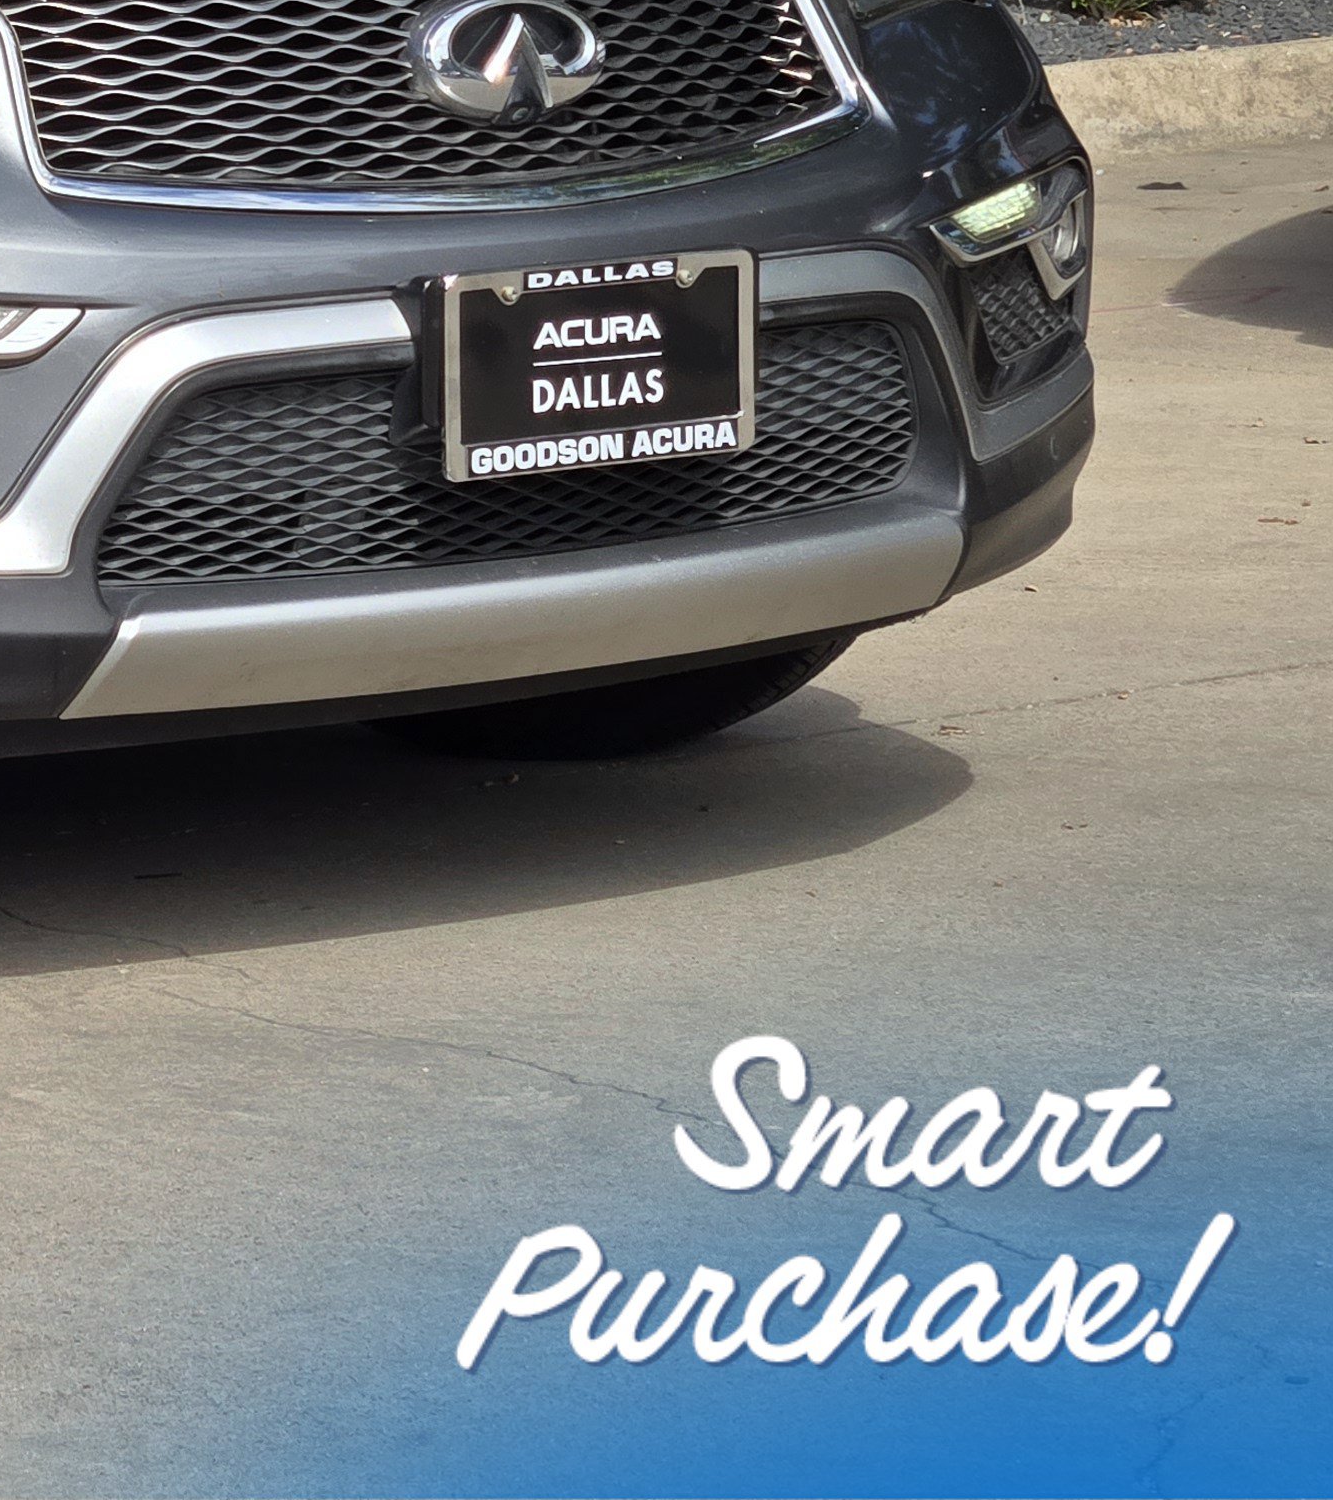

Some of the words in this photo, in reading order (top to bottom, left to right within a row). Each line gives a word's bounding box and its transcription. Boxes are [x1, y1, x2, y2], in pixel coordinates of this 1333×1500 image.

[527, 260, 675, 289] DALLAS
[533, 313, 662, 350] ACURA
[533, 368, 664, 414] DALLAS
[471, 433, 624, 474] GOODSON
[631, 421, 737, 457] ACURA
